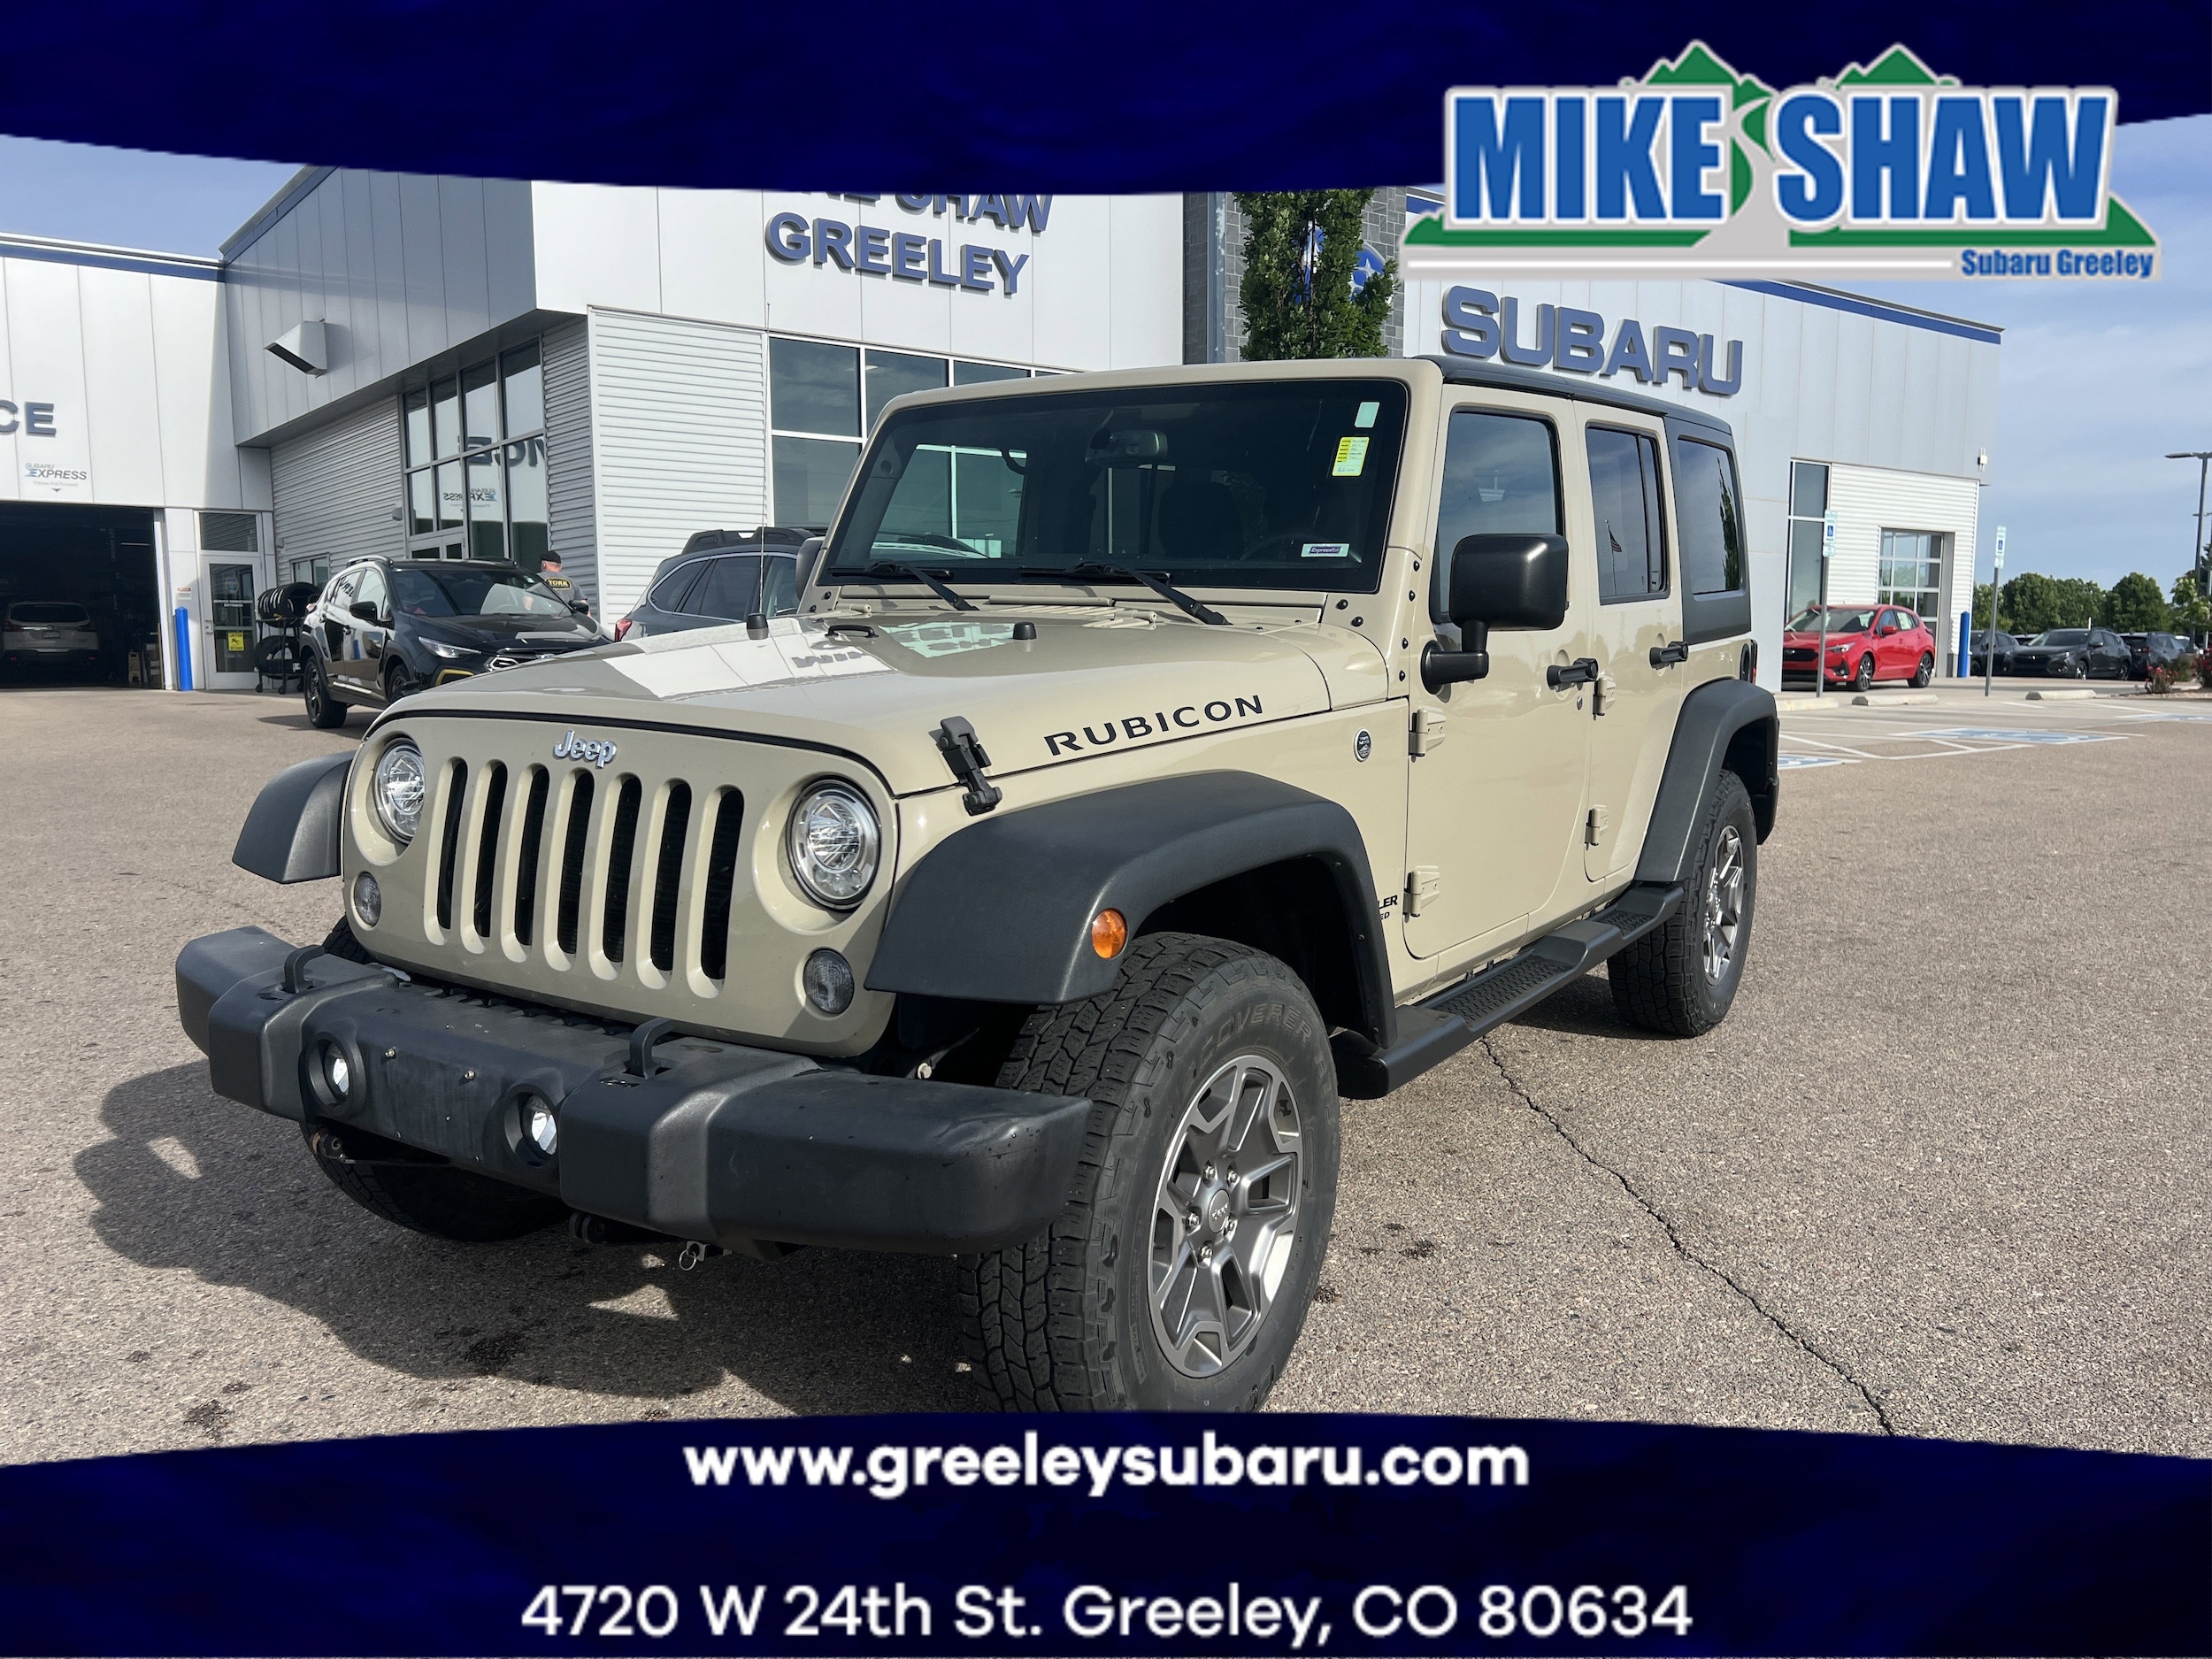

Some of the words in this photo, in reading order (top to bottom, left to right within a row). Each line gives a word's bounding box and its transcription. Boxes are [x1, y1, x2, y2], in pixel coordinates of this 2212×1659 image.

[765, 211, 1030, 299] GREELEY
[1441, 284, 1743, 397] SUBARU
[25, 468, 87, 480] EXPRESS
[553, 730, 617, 769] Jeep
[1043, 695, 1263, 757] RUBICON
